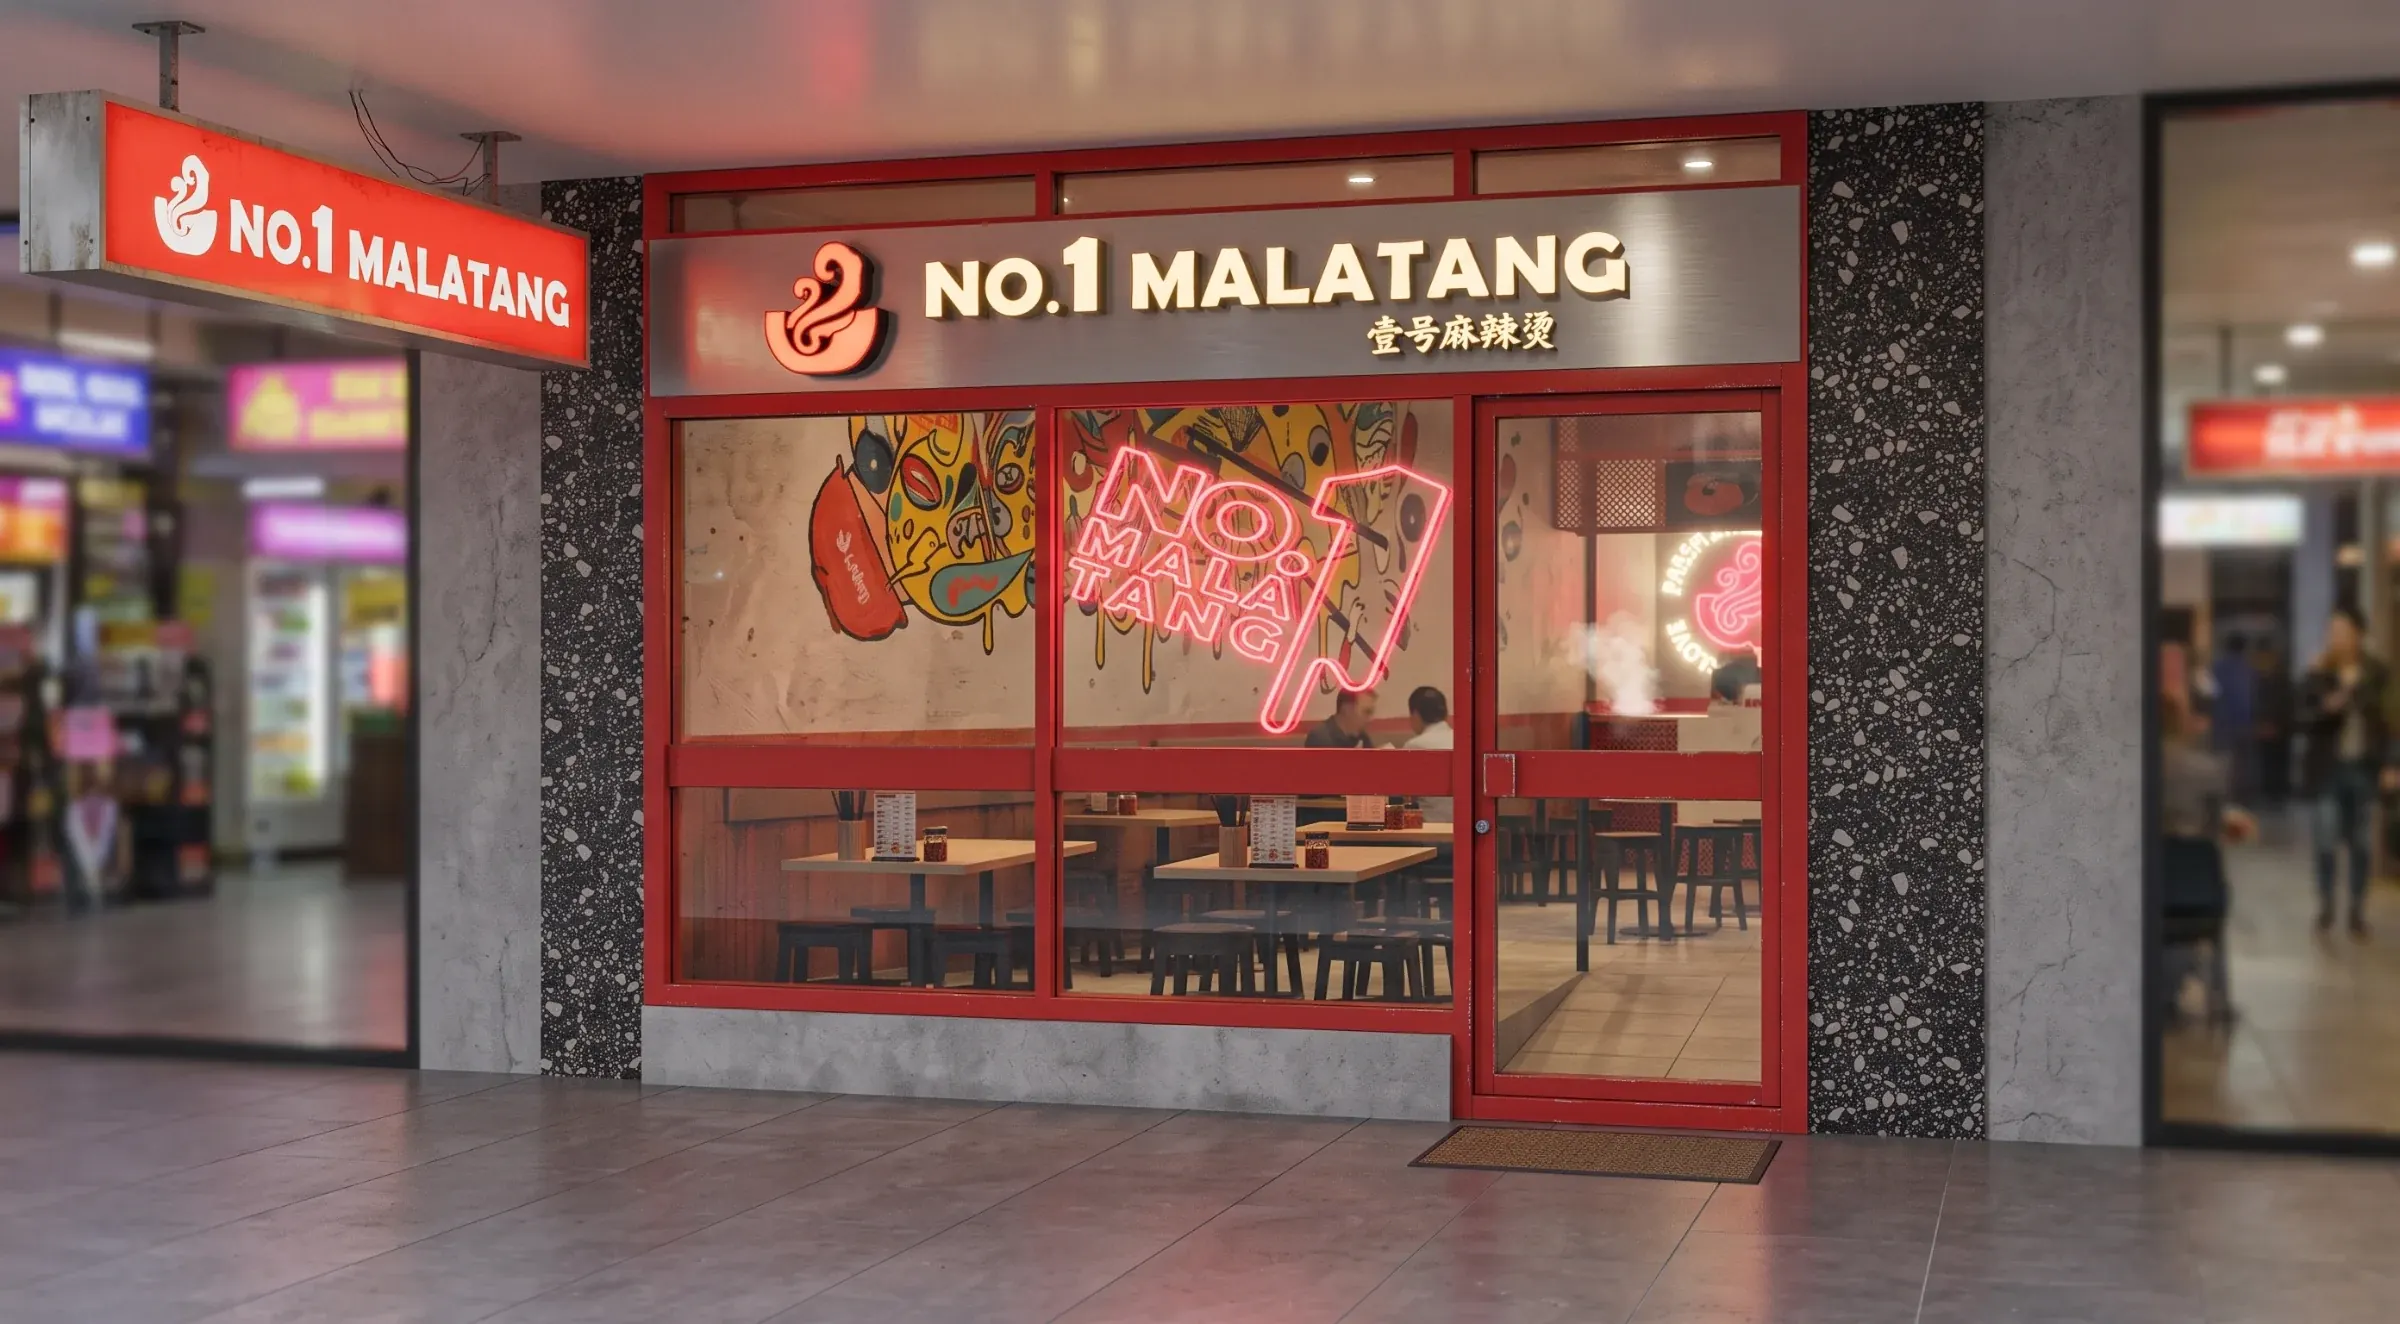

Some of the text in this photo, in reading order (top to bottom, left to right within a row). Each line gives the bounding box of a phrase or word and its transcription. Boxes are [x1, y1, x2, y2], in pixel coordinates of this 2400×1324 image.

[230, 199, 570, 328] NO.1 MALATANG
[925, 231, 1630, 318] NO.1 MALATANG
[1367, 310, 1556, 355] 壹号麻辣烫
[1067, 556, 1284, 663] TANG
[1076, 516, 1291, 622] MALA
